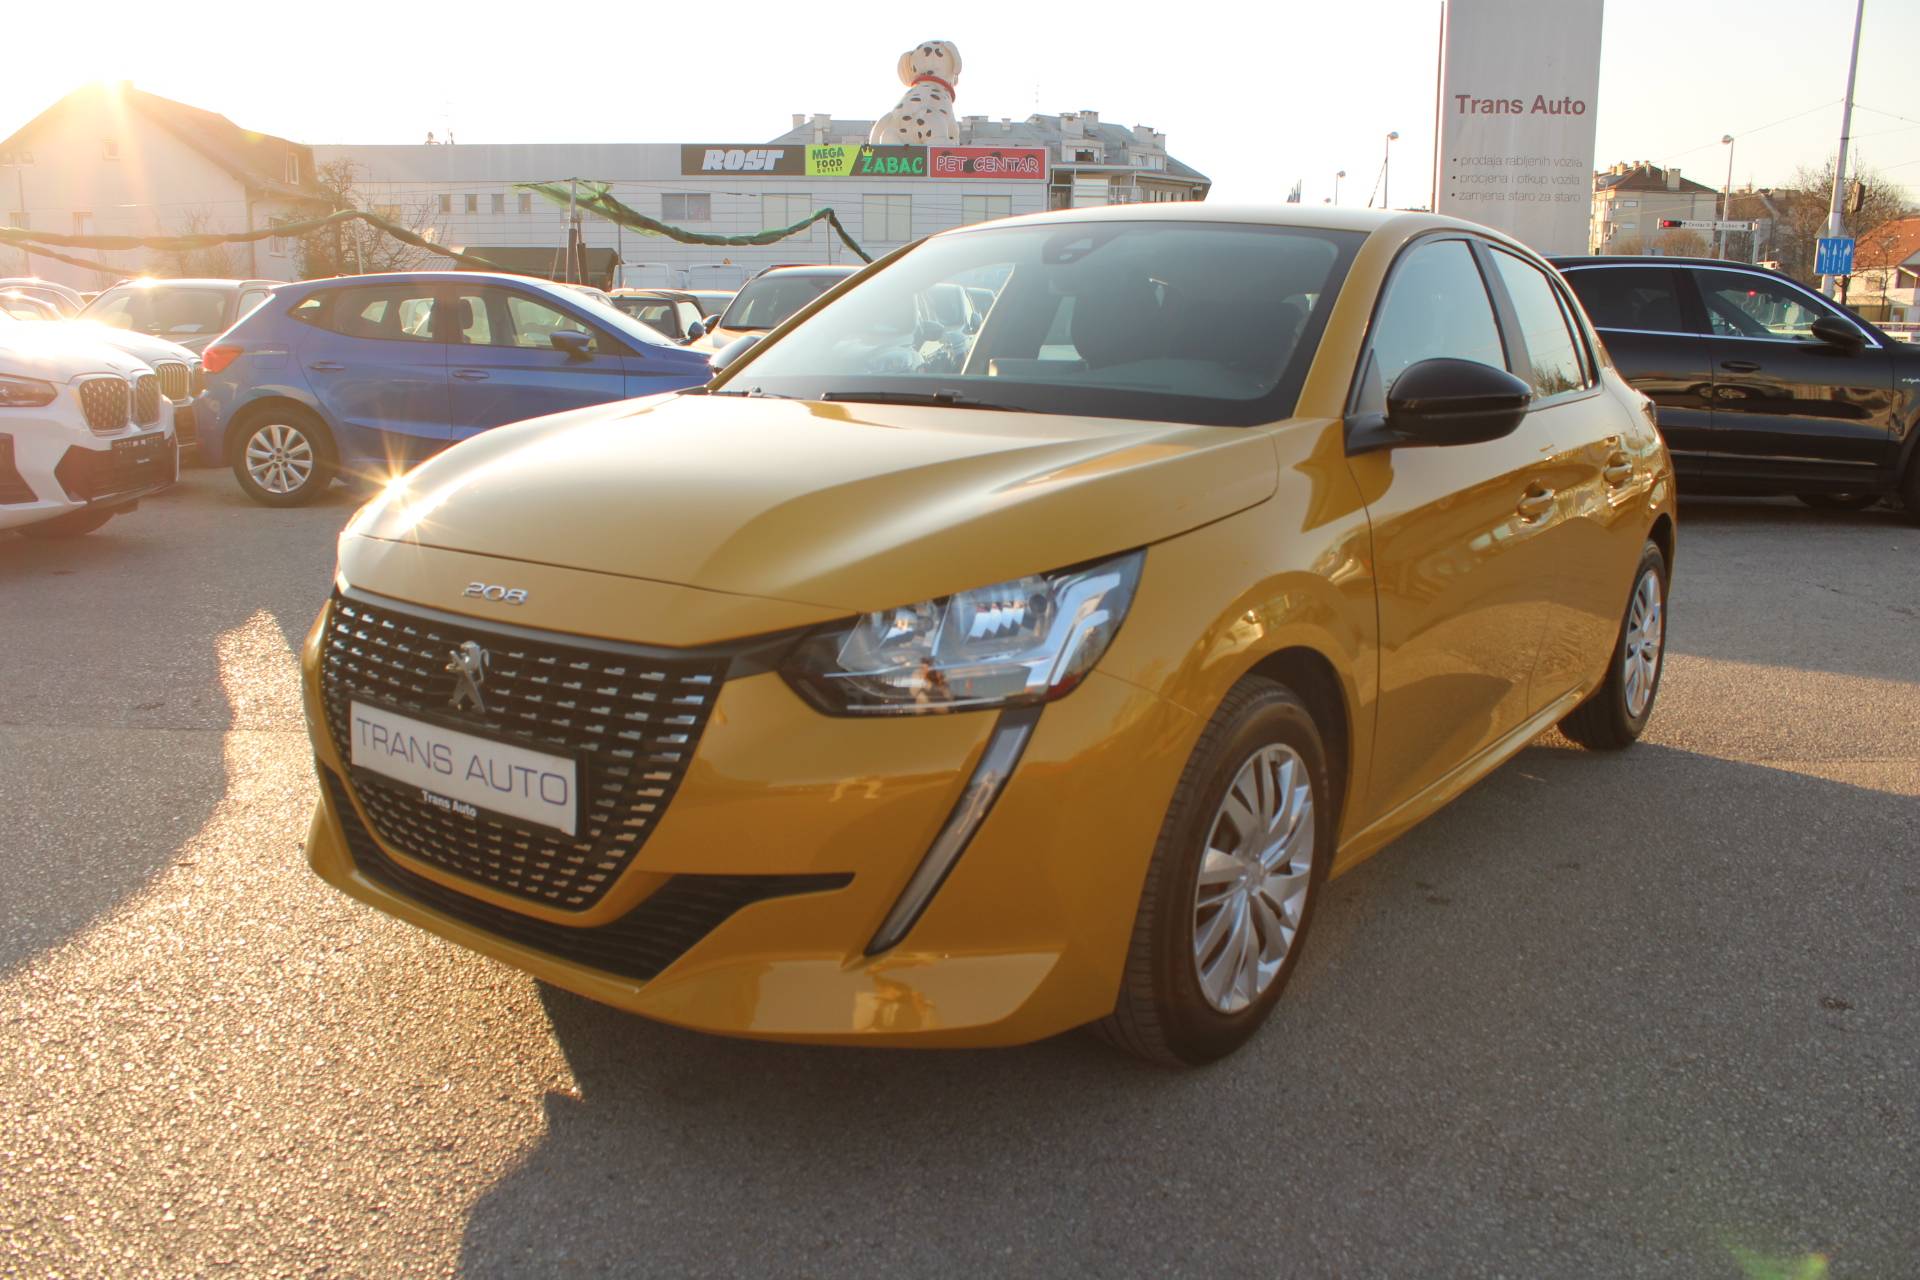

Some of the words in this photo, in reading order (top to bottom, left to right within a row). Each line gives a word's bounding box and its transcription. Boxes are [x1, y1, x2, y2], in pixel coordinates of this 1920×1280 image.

[1455, 94, 1524, 115] Trans
[1530, 94, 1586, 116] Auto
[702, 149, 785, 171] ROST
[812, 147, 845, 160] MEGA
[816, 159, 843, 169] FOOD
[936, 156, 968, 172] PET
[973, 156, 1040, 173] CENTAR
[1460, 155, 1503, 168] prodaja
[1505, 155, 1551, 169] rabljenih
[1553, 156, 1583, 168] vozila
[816, 166, 843, 174] OUTLET
[1460, 174, 1508, 187] procjena
[1517, 173, 1549, 187] otkup
[1551, 174, 1581, 186] vozila
[1458, 191, 1505, 203] zamjena
[1508, 190, 1536, 201] staro
[1538, 192, 1551, 202] za
[1553, 191, 1582, 203] staro
[463, 582, 528, 605] 208
[356, 717, 453, 775] TRANS
[465, 754, 568, 806] AUTO
[421, 789, 451, 810] Trans
[452, 800, 478, 818] Auto
